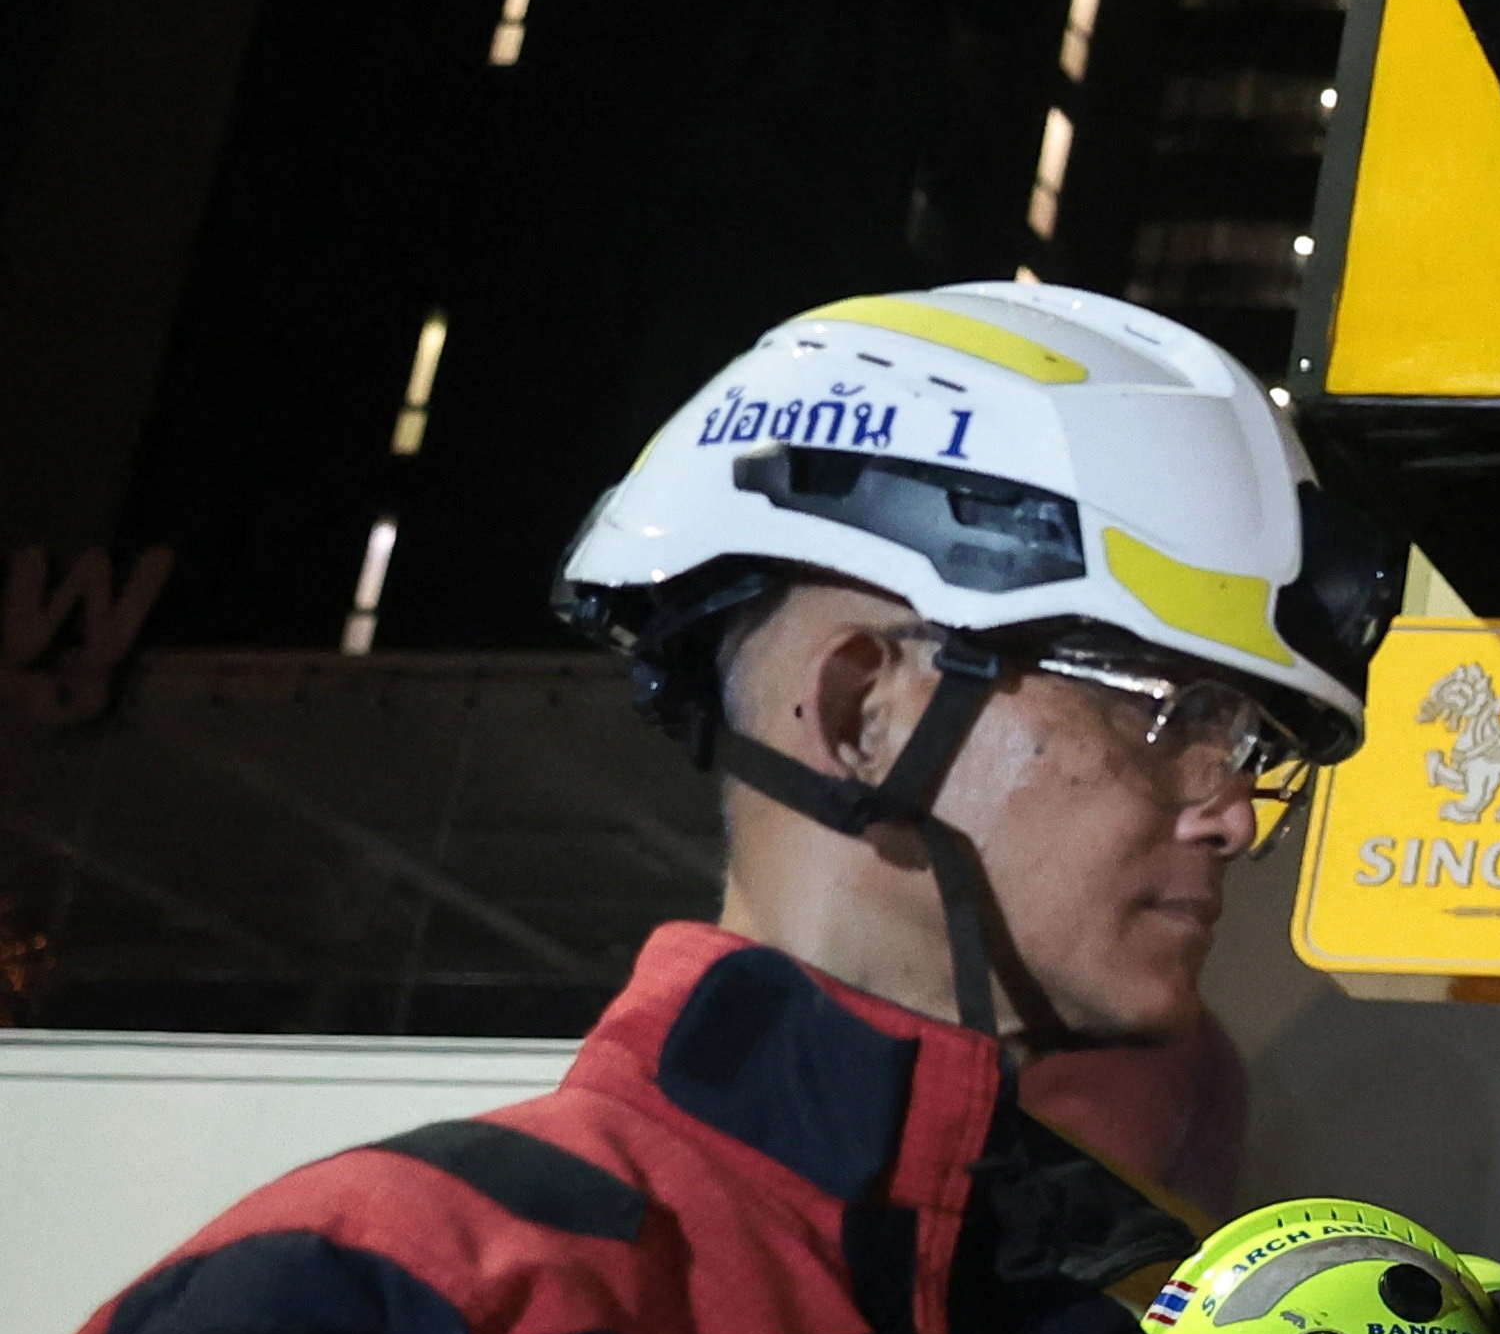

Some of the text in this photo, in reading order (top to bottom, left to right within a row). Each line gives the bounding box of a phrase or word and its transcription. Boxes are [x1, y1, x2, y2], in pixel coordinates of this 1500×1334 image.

[697, 381, 974, 460] ป้องกัน 1
[1201, 1229, 1312, 1317] SARCH
